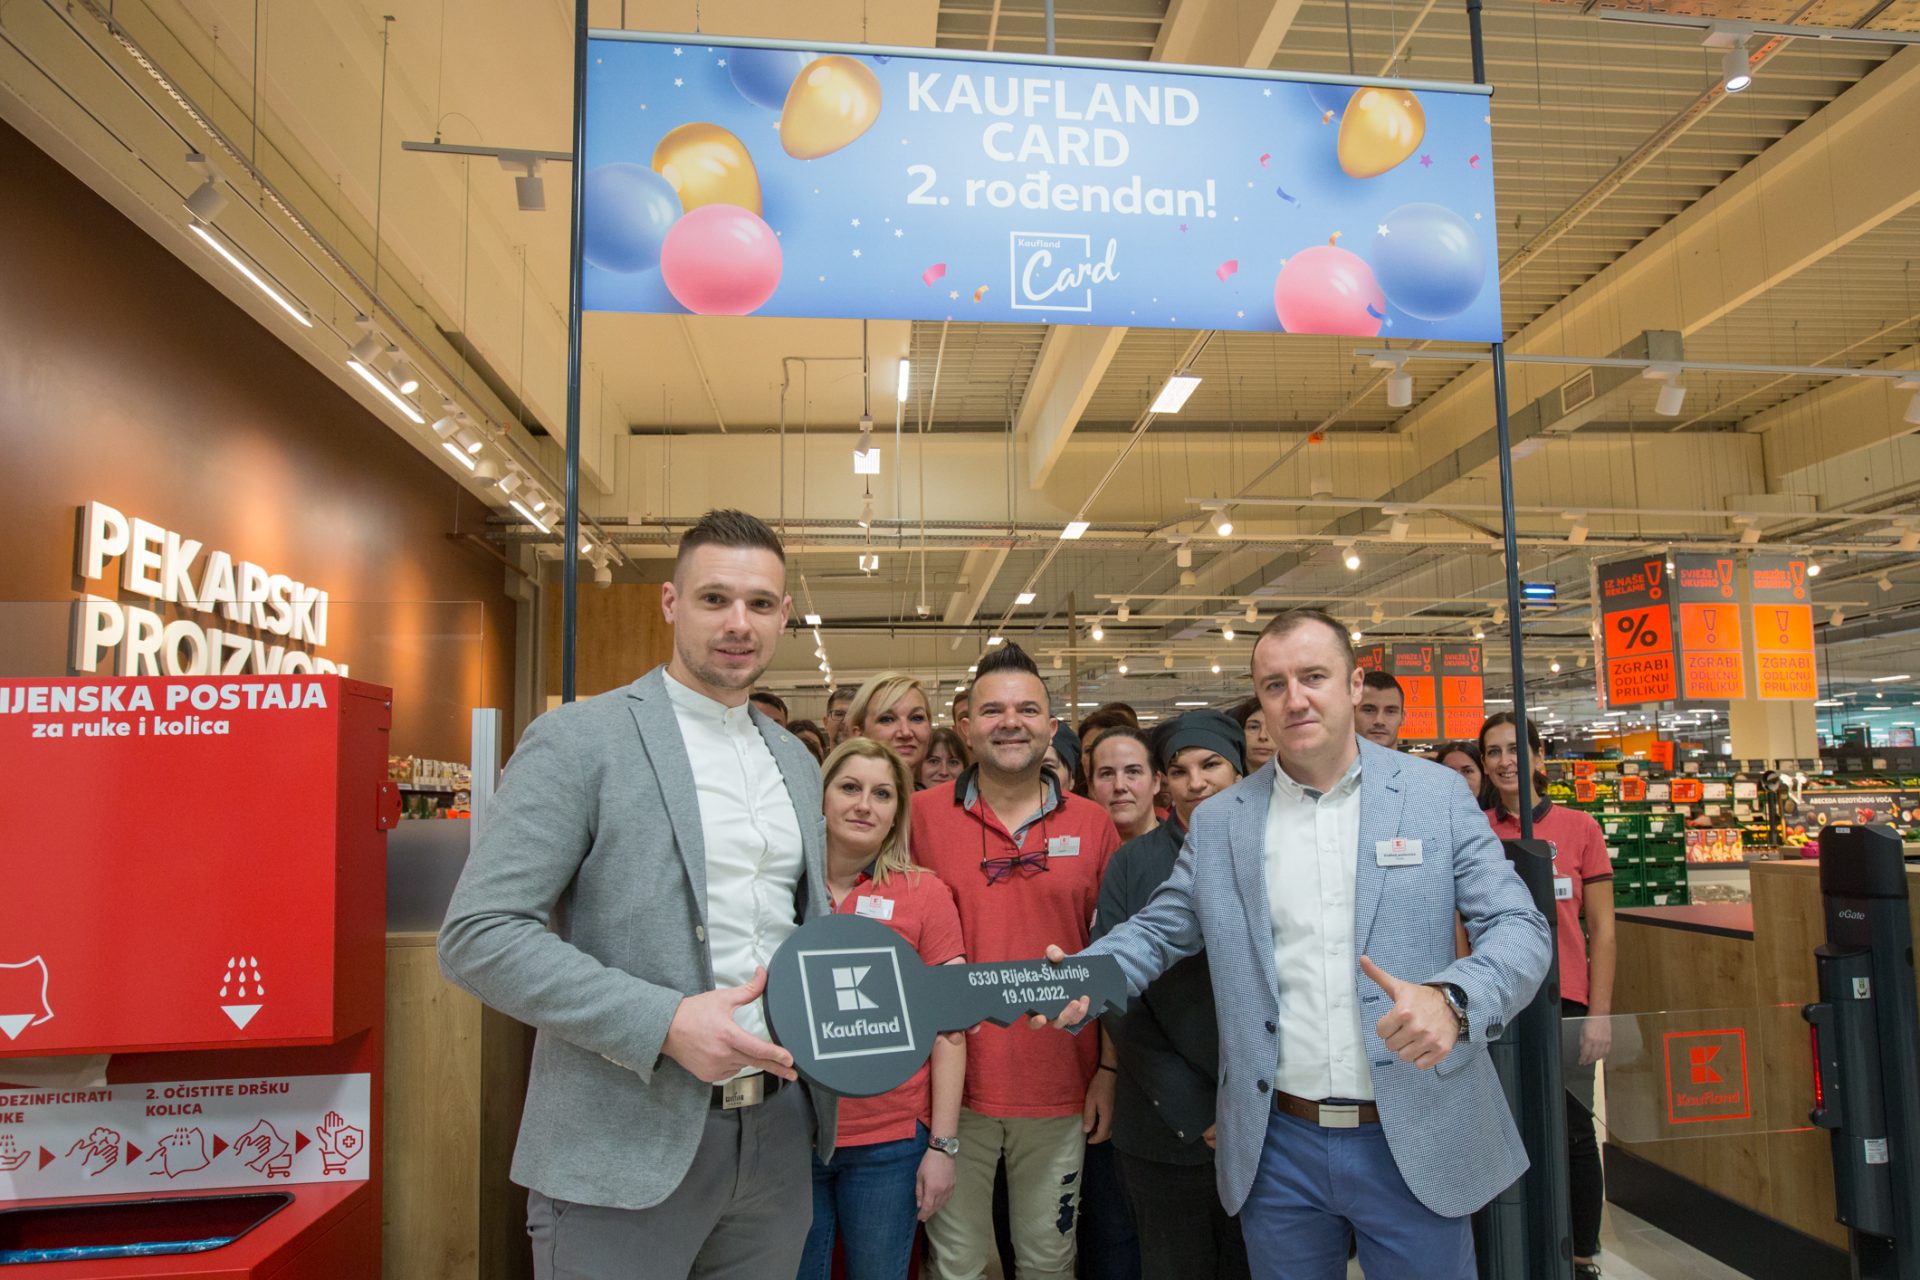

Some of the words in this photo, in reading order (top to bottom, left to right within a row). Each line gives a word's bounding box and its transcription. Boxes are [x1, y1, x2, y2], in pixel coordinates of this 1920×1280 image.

[908, 71, 1199, 126] KAUFLAND
[982, 122, 1130, 167] CARD
[906, 164, 949, 206] 2.
[965, 170, 1216, 218] rođendan!
[1018, 238, 1061, 249] Kaufland
[1022, 238, 1120, 301] Card
[79, 500, 328, 647] PEKARSKI
[74, 593, 348, 677] PROIZV
[1614, 658, 1669, 675] ZGRABI
[1689, 657, 1738, 669] ZGRABI
[1762, 657, 1810, 669] ZGRABI
[166, 683, 328, 711] POSTAJA
[32, 722, 64, 738] za
[71, 717, 131, 737] ruke
[138, 717, 146, 735] i
[154, 716, 230, 735] kolica
[1839, 909, 1865, 920] eGate
[968, 971, 999, 986] 6330
[1000, 963, 1090, 986] Rijeka-Škurinje
[1002, 985, 1070, 1004] 19.10.2022.
[821, 1016, 900, 1039] Kaufland
[0, 1090, 112, 1107] DEZINFICIRATI
[146, 1088, 159, 1100] 2.
[164, 1084, 234, 1099] OČISTITE
[238, 1082, 290, 1095] DRŠKU
[1677, 1088, 1739, 1106] Kaufland
[146, 1103, 203, 1116] KOLICA
